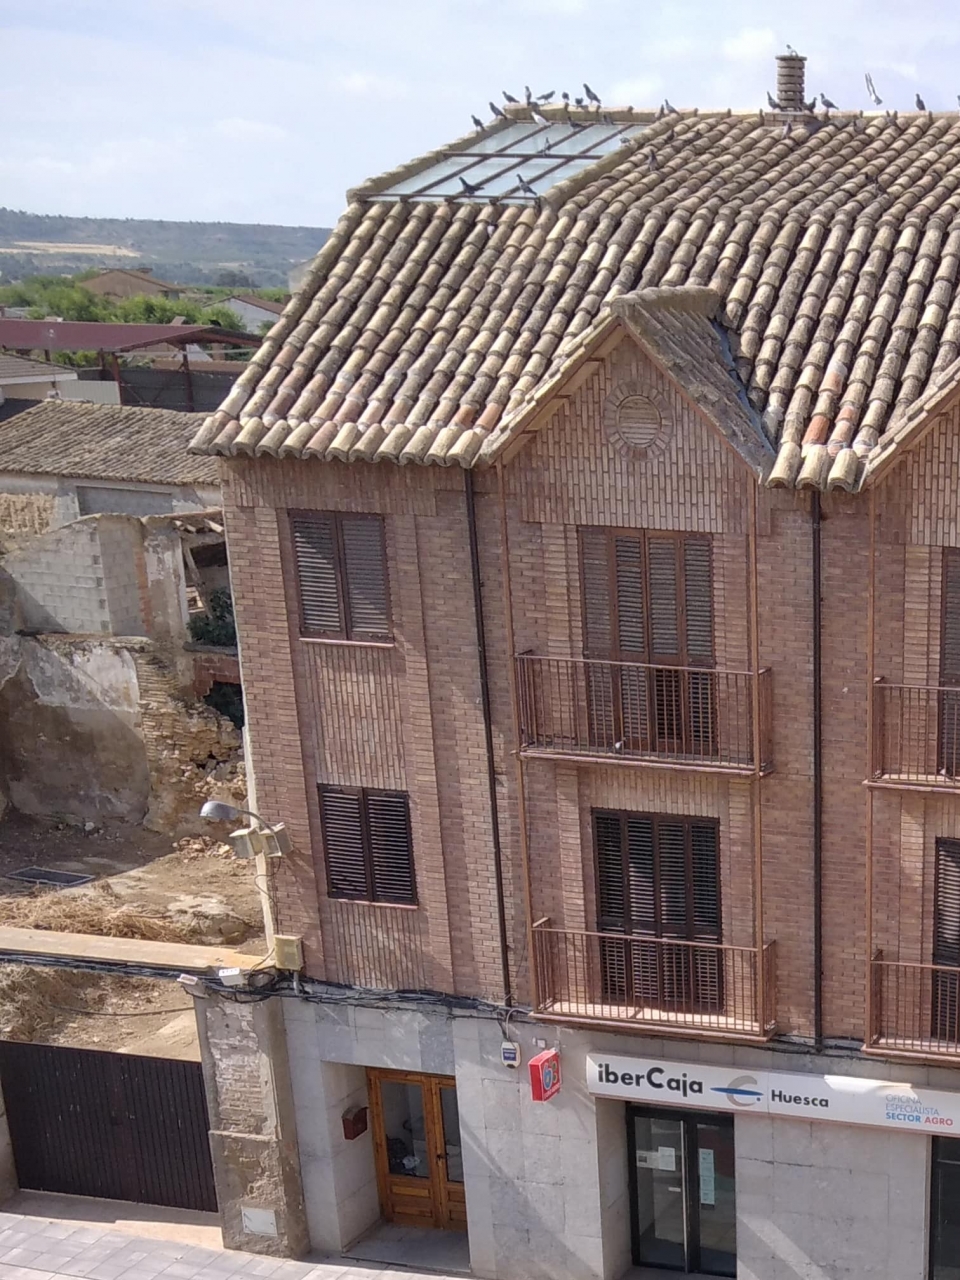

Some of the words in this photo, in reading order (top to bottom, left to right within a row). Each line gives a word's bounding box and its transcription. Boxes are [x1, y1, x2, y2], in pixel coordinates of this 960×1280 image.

[598, 1063, 703, 1097] iberCaja
[771, 1089, 829, 1108] Huesca
[885, 1093, 922, 1105] OFICINA
[885, 1103, 940, 1116] ESPECIALISTA
[885, 1111, 922, 1123] SECTOR
[924, 1116, 954, 1127] AGRO
